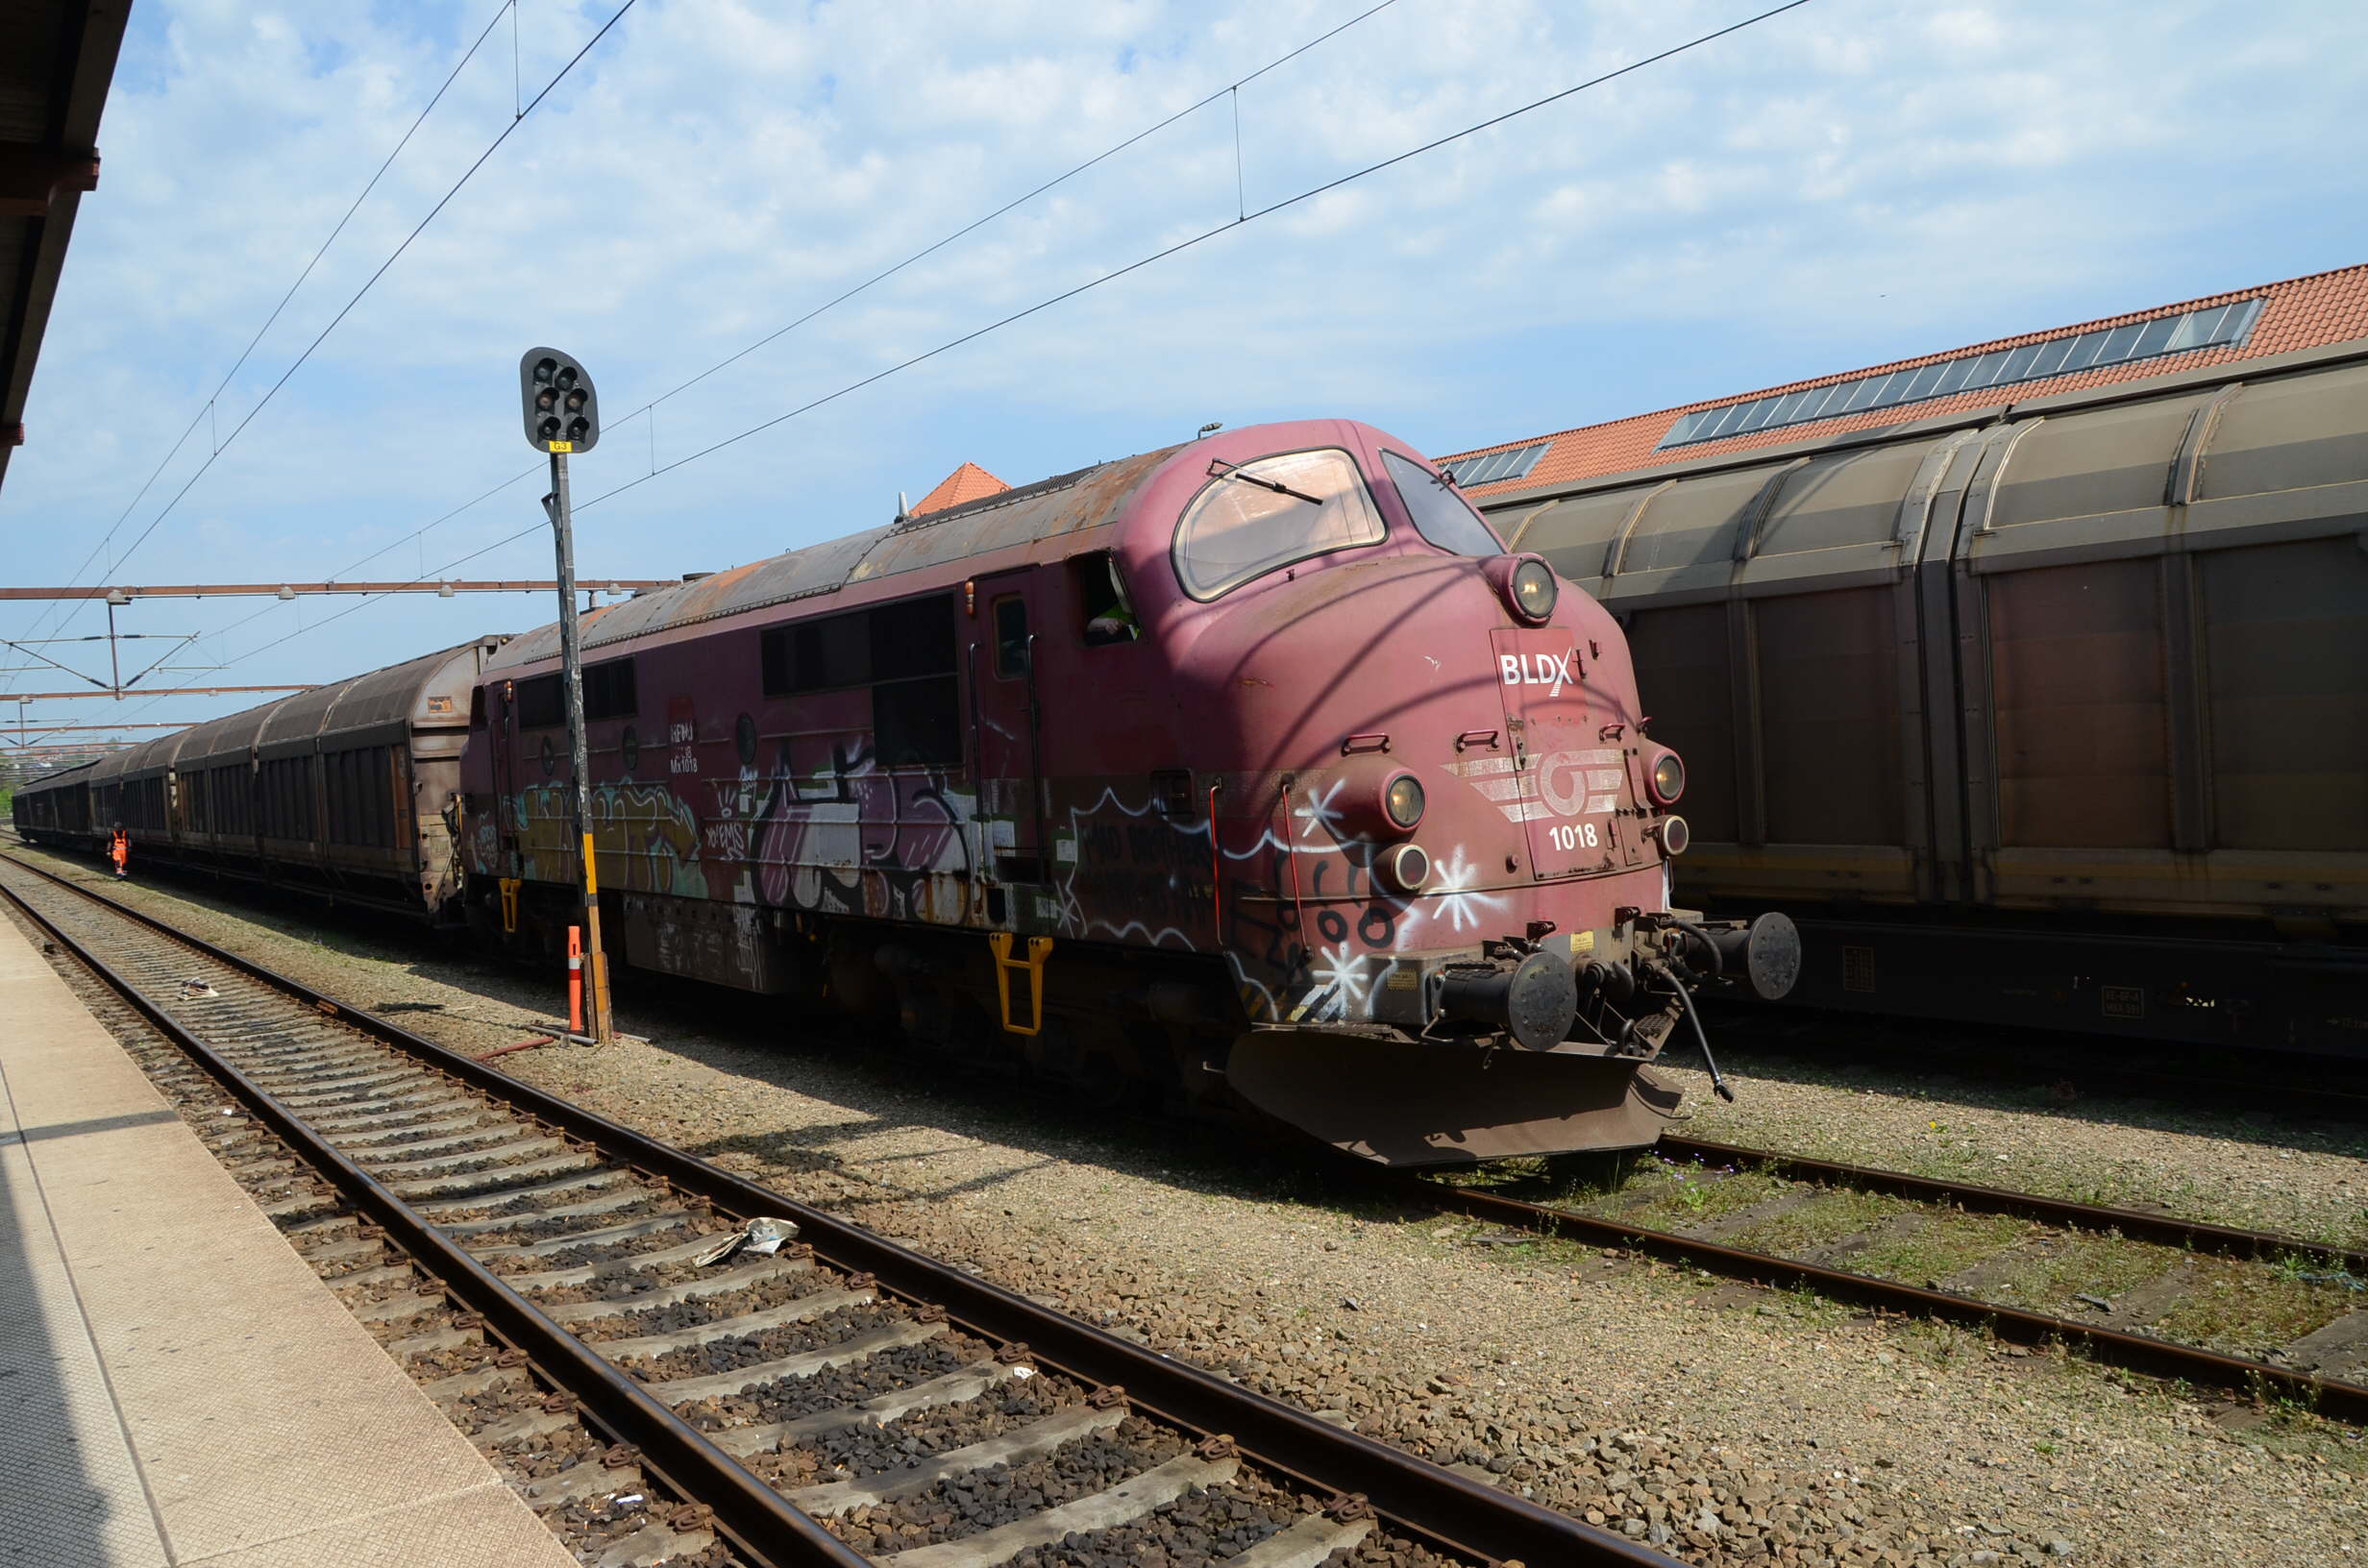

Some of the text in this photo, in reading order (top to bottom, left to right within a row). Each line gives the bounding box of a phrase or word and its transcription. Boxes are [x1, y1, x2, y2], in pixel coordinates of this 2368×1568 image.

[554, 441, 568, 452] G3
[1499, 647, 1574, 698] BLDX
[1548, 822, 1599, 851] 1018
